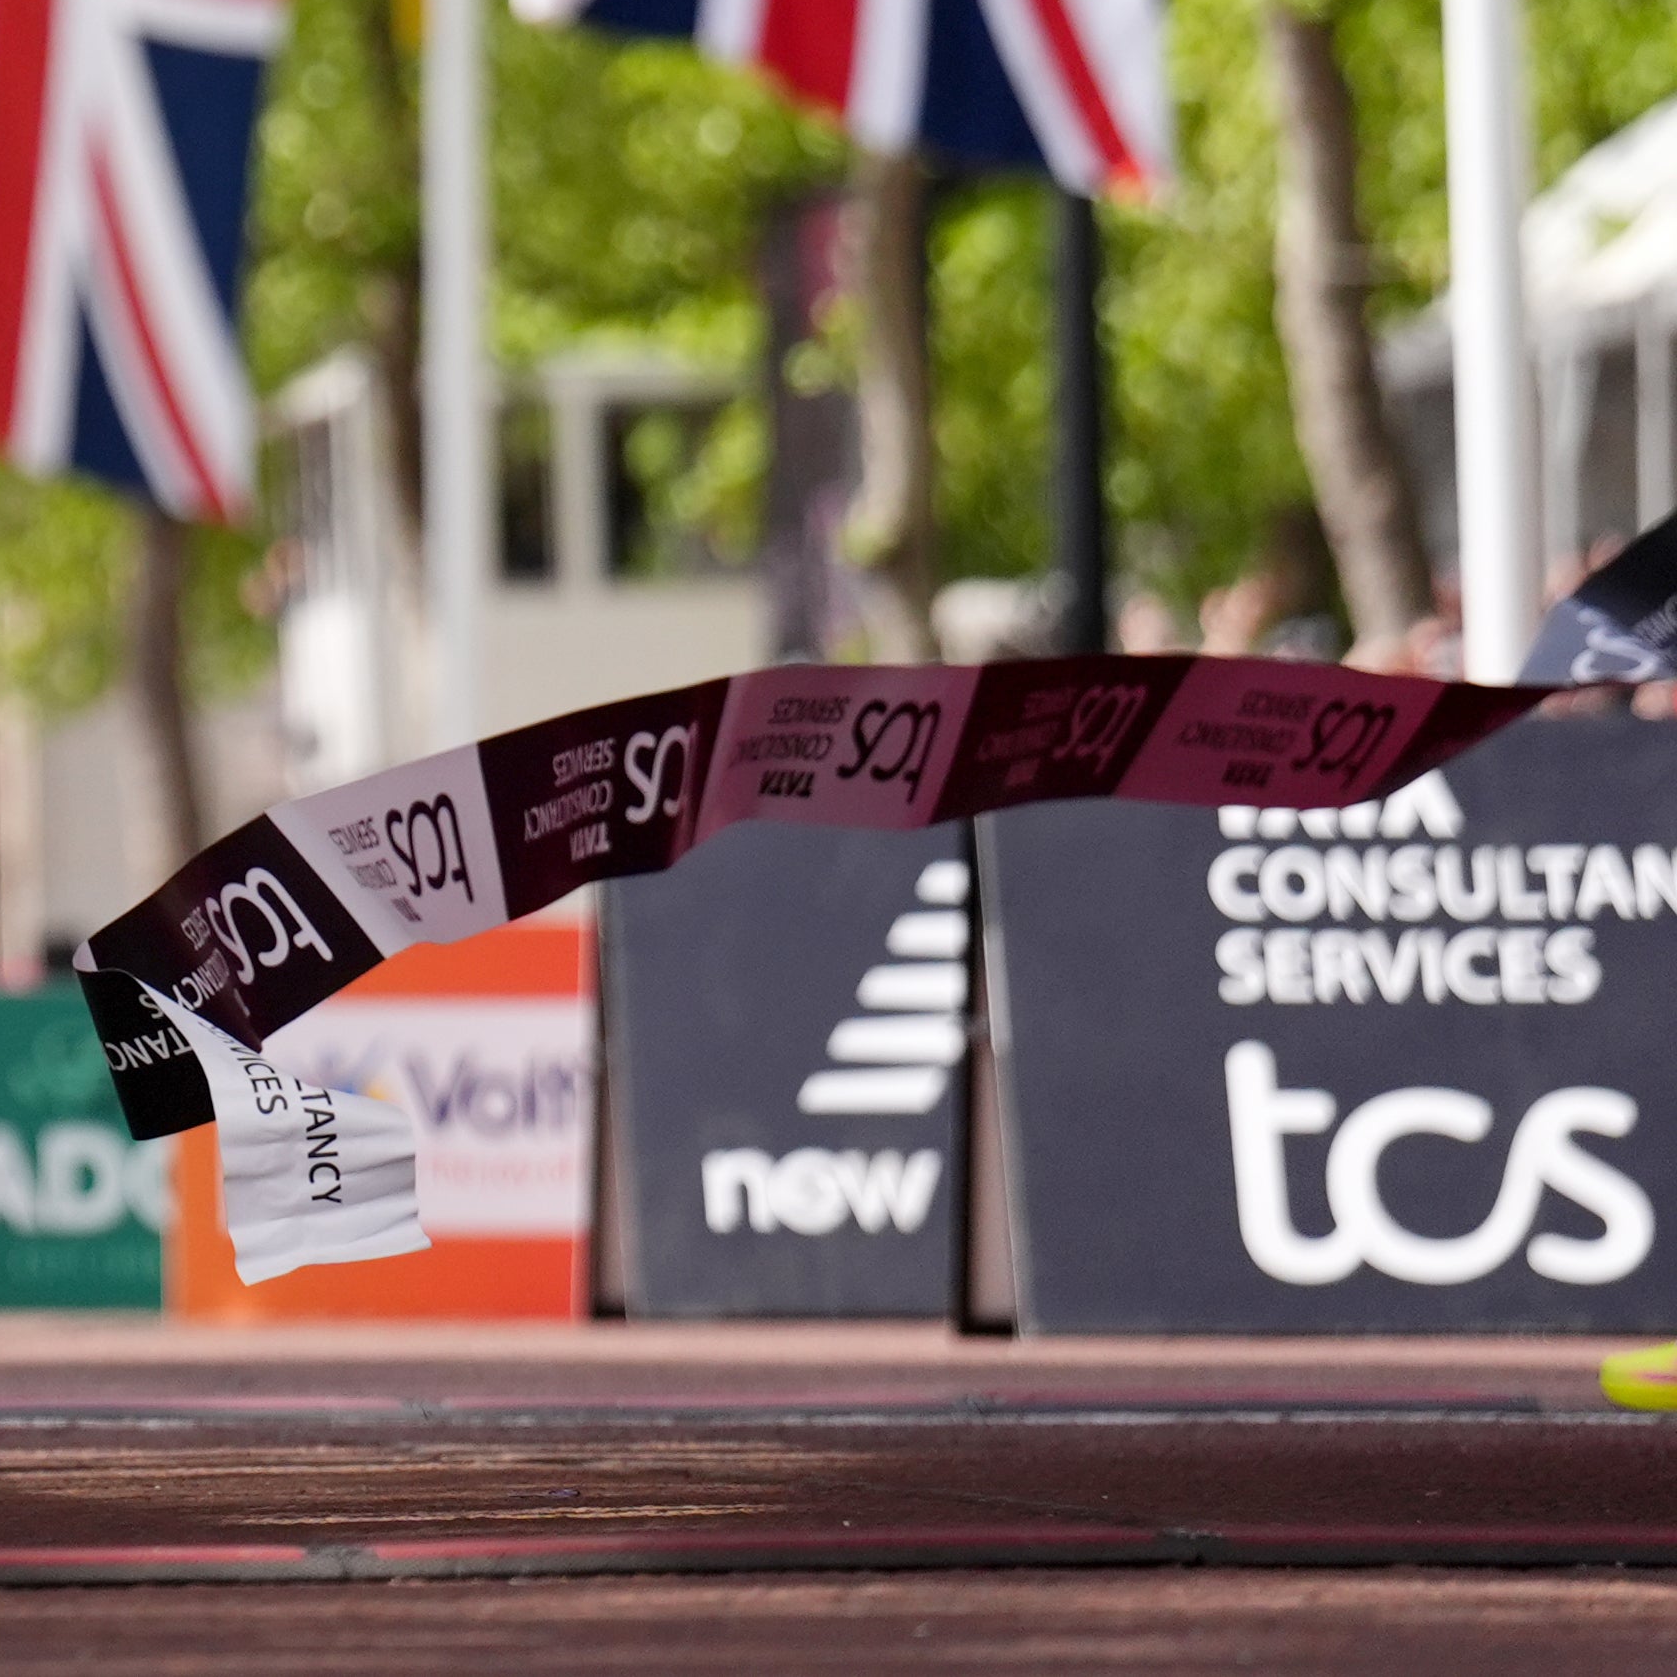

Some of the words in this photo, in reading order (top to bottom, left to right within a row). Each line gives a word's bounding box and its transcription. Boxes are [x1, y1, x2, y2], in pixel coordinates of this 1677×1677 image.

[758, 770, 815, 798] TATA
[835, 698, 943, 805] tcs
[1291, 696, 1396, 790] tcs
[385, 792, 474, 903] tcs
[569, 821, 613, 863] TATA
[1207, 843, 1677, 924] CONSULTAN
[206, 867, 333, 986] tcs
[1214, 925, 1606, 1007] SERVICES
[700, 1146, 945, 1236] new
[1222, 1038, 1657, 1288] tcs
